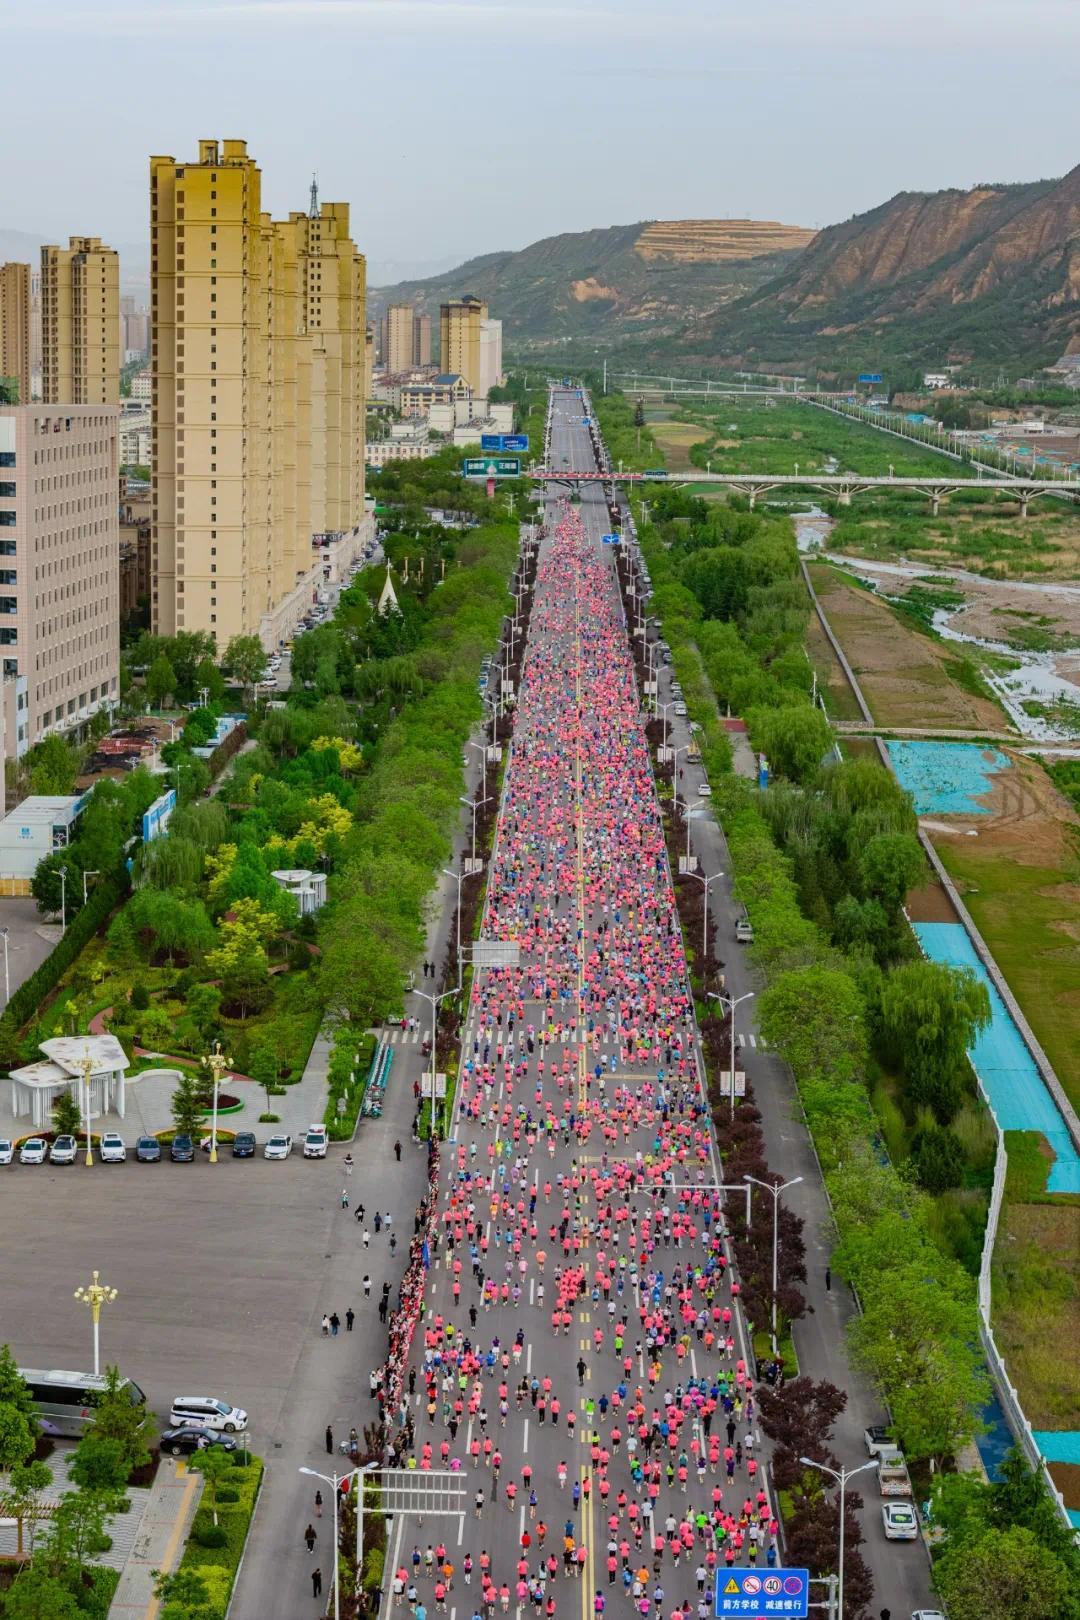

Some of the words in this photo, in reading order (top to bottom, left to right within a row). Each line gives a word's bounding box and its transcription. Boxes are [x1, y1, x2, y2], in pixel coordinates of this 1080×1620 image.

[766, 1580, 778, 1592] 40
[723, 1599, 759, 1610] 前方学校
[765, 1599, 802, 1610] 减速慢行
